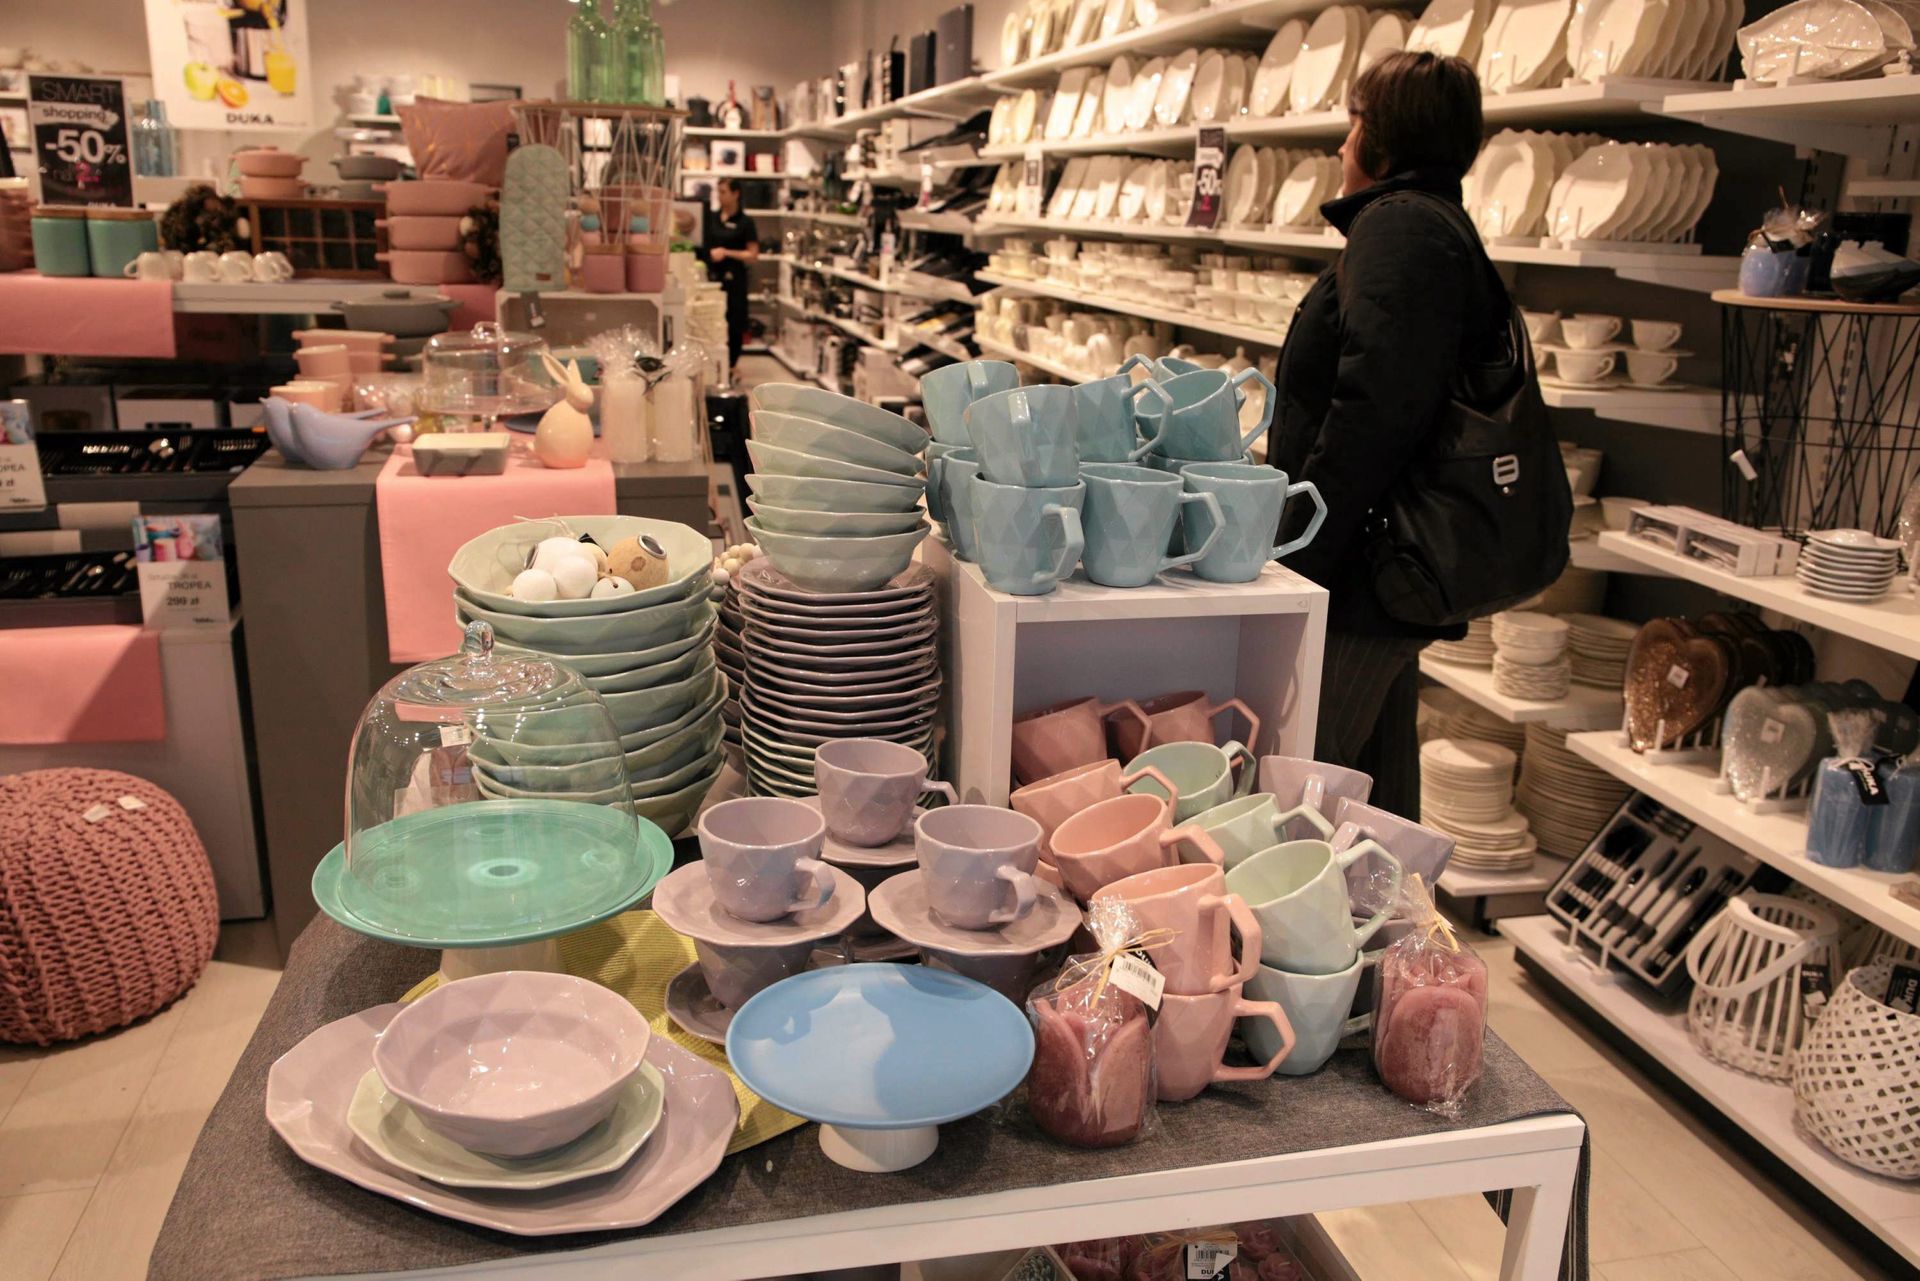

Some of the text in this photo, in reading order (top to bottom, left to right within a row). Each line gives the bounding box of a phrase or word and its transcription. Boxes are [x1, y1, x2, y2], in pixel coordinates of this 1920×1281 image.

[41, 80, 117, 103] SMART
[42, 106, 107, 122] shopping
[226, 113, 274, 125] DUKA
[45, 129, 126, 164] -50%
[168, 581, 212, 590] TROPEA
